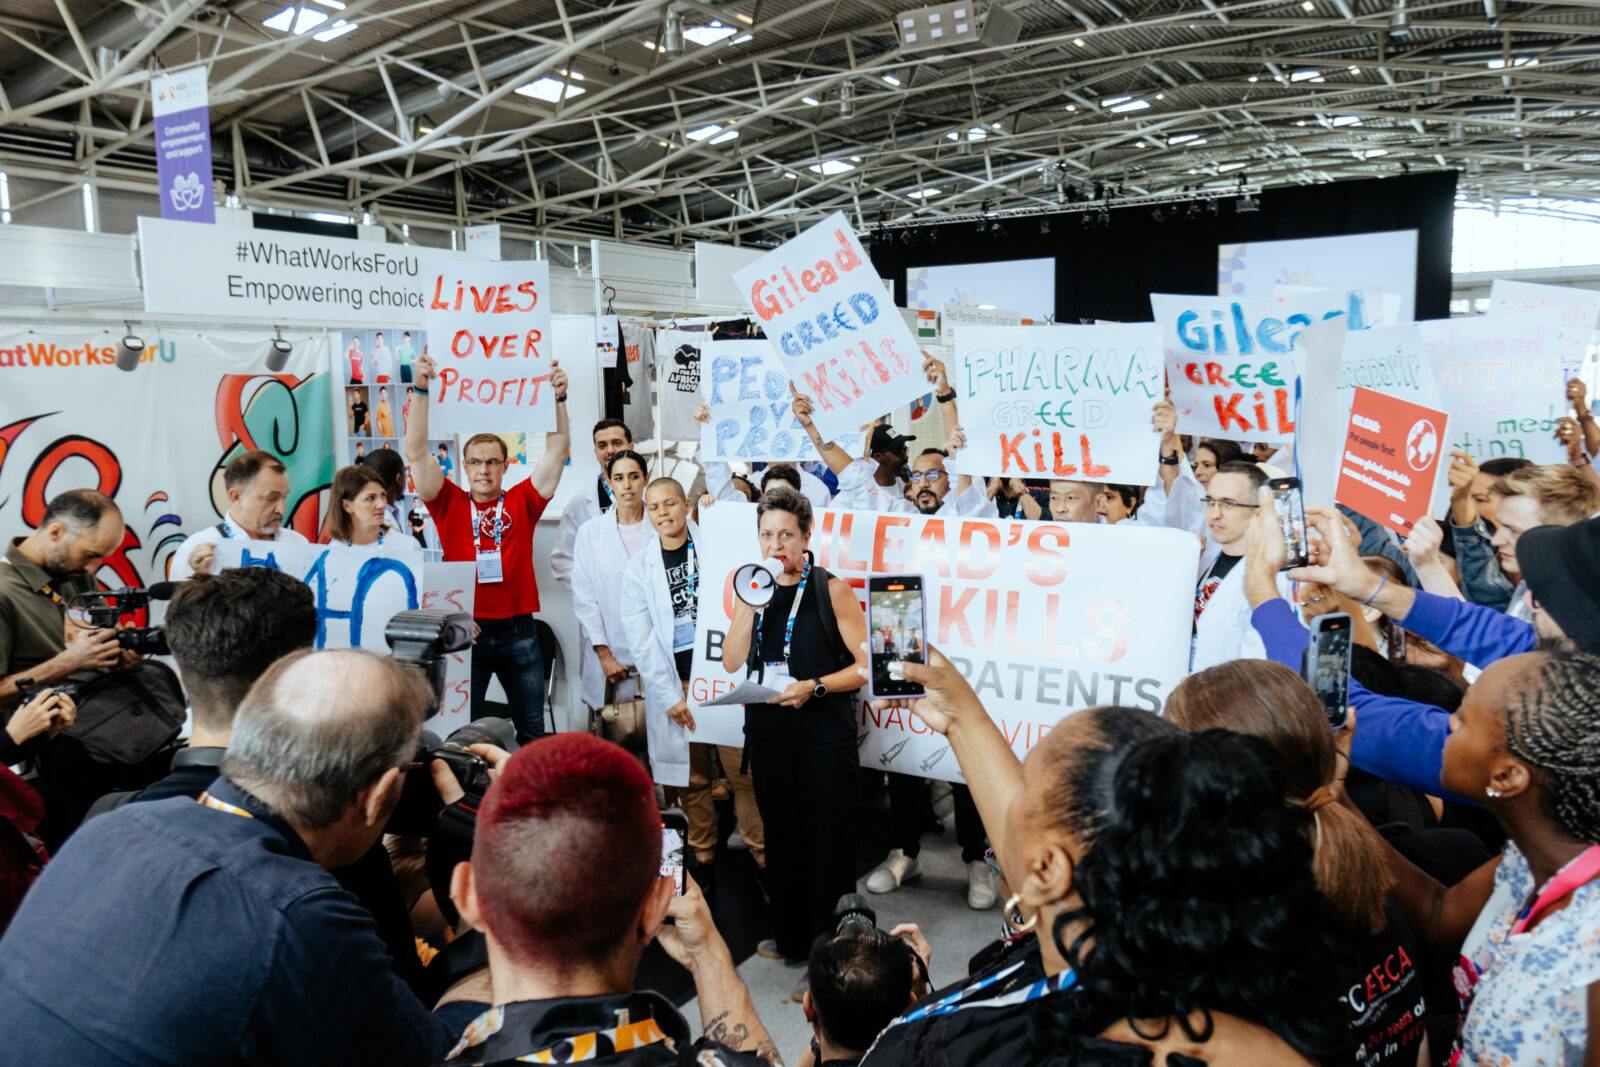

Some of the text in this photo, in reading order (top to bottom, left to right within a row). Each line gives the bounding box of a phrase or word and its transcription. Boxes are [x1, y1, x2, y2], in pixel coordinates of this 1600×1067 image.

[236, 240, 419, 277] #WhatWorksForU
[751, 227, 863, 322] Gilead
[228, 275, 363, 310] Empowering
[452, 329, 542, 359] OVER
[438, 367, 550, 407] PROFIT
[965, 345, 1159, 399] PHARMA
[1496, 403, 1560, 435] med
[813, 512, 1071, 587] ILEAD'S
[937, 584, 1133, 664] KILLS
[948, 655, 1163, 715] PATENTS
